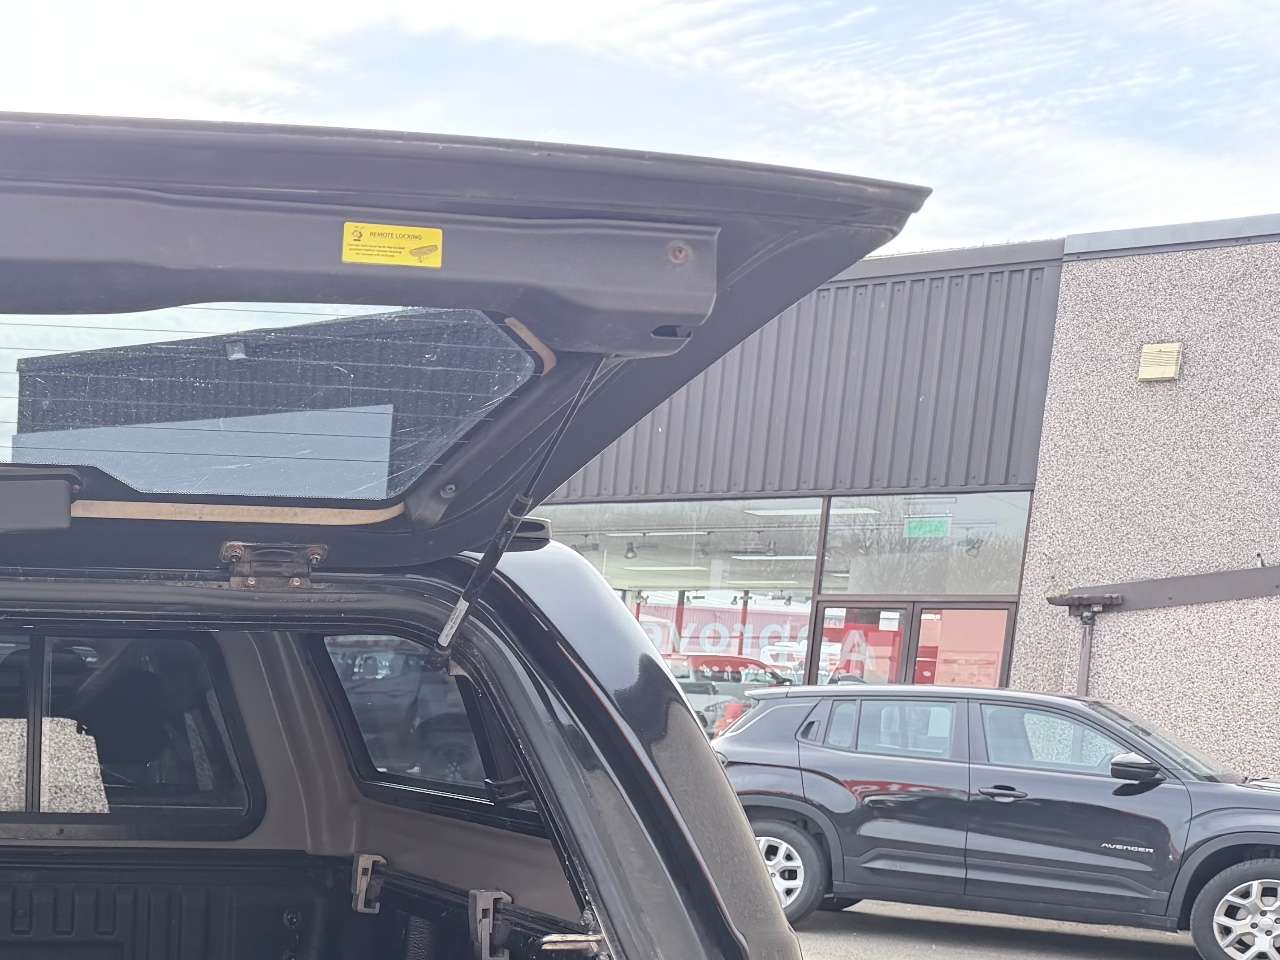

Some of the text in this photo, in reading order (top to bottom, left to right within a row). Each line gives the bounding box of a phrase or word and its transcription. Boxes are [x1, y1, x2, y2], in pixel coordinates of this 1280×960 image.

[369, 231, 422, 241] REMOTE LOCKING
[1100, 843, 1153, 853] AVENGER
